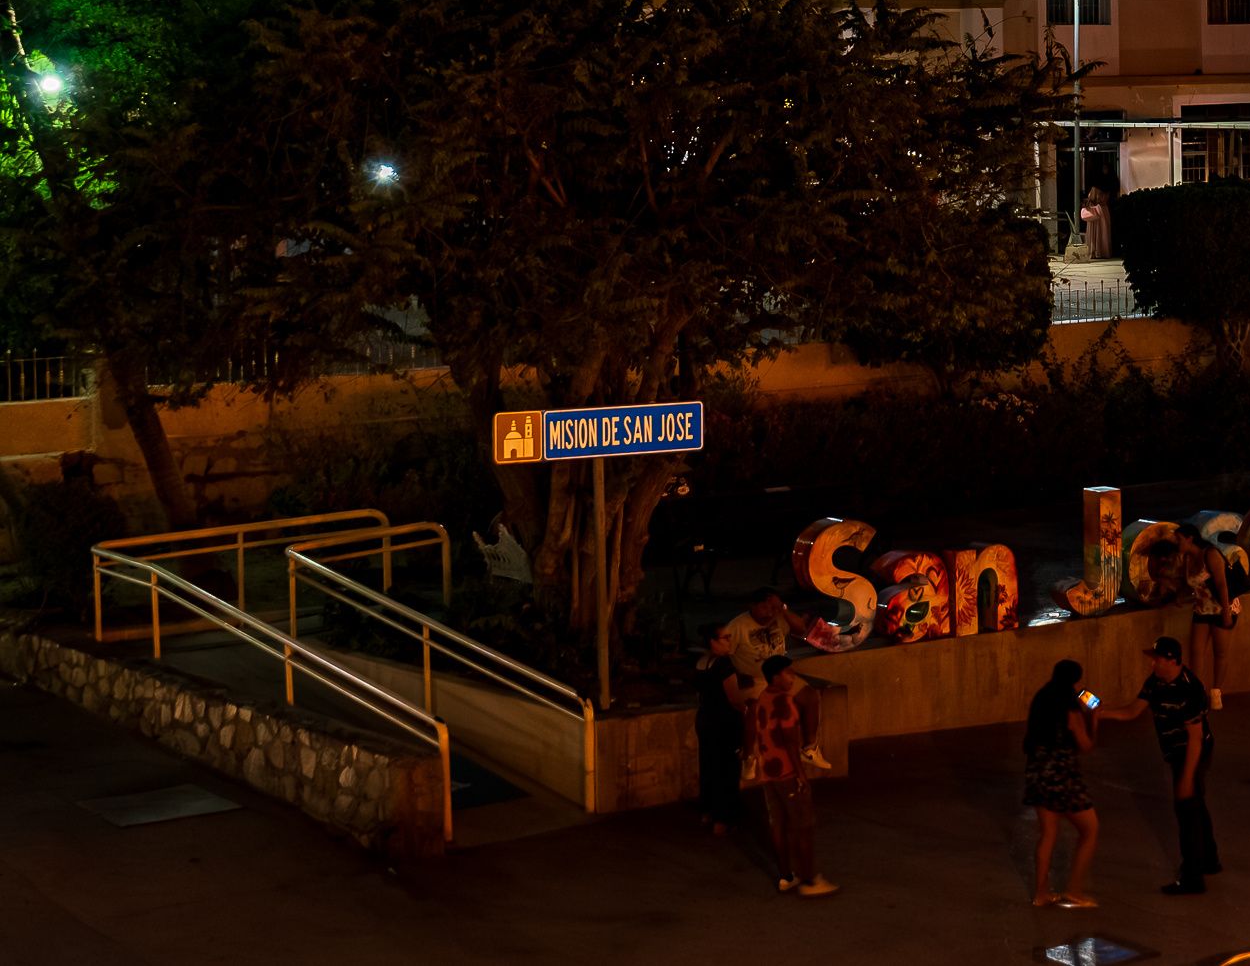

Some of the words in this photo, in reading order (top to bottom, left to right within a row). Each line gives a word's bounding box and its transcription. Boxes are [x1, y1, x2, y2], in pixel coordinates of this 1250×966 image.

[550, 418, 598, 450] MISION
[602, 416, 620, 446] DE
[623, 415, 653, 445] SAN
[657, 412, 694, 442] JOSE
[792, 517, 1019, 653] San
